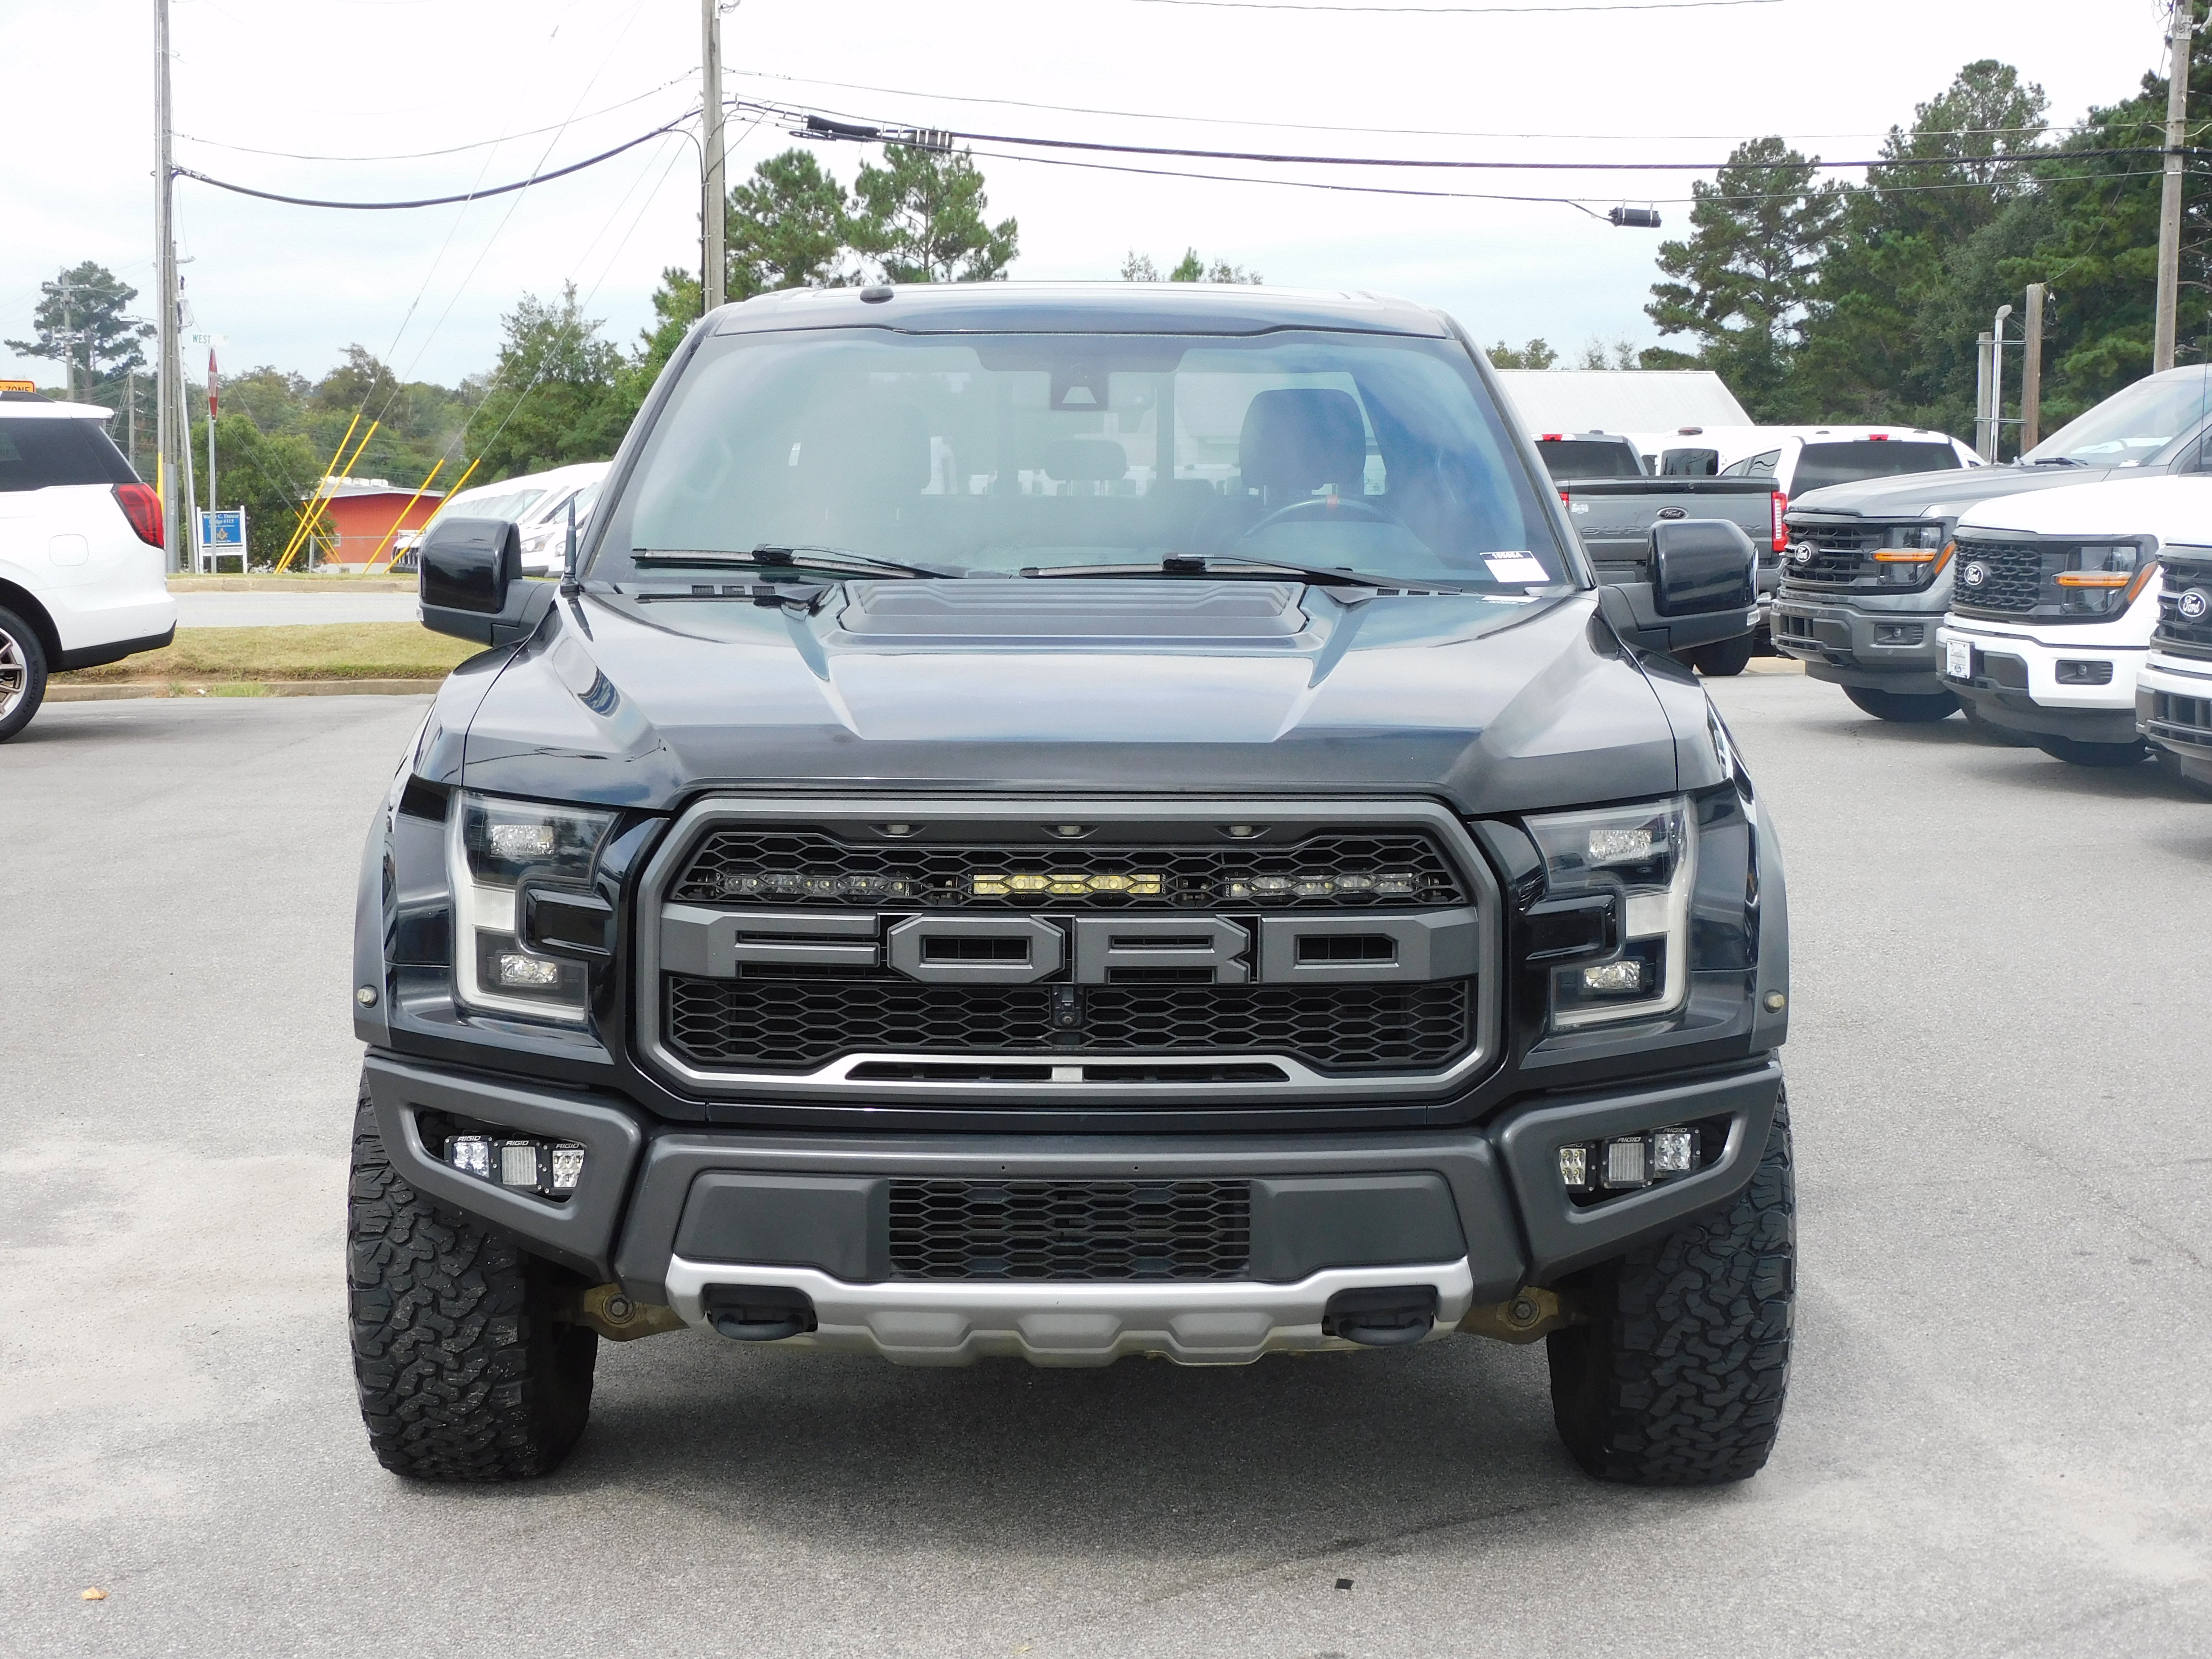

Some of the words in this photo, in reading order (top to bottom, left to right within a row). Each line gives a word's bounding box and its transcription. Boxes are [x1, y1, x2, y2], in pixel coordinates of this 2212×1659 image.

[192, 334, 211, 344] WEST
[1967, 567, 1980, 582] Ford
[2183, 595, 2200, 613] Ford
[660, 903, 1479, 984] FORD
